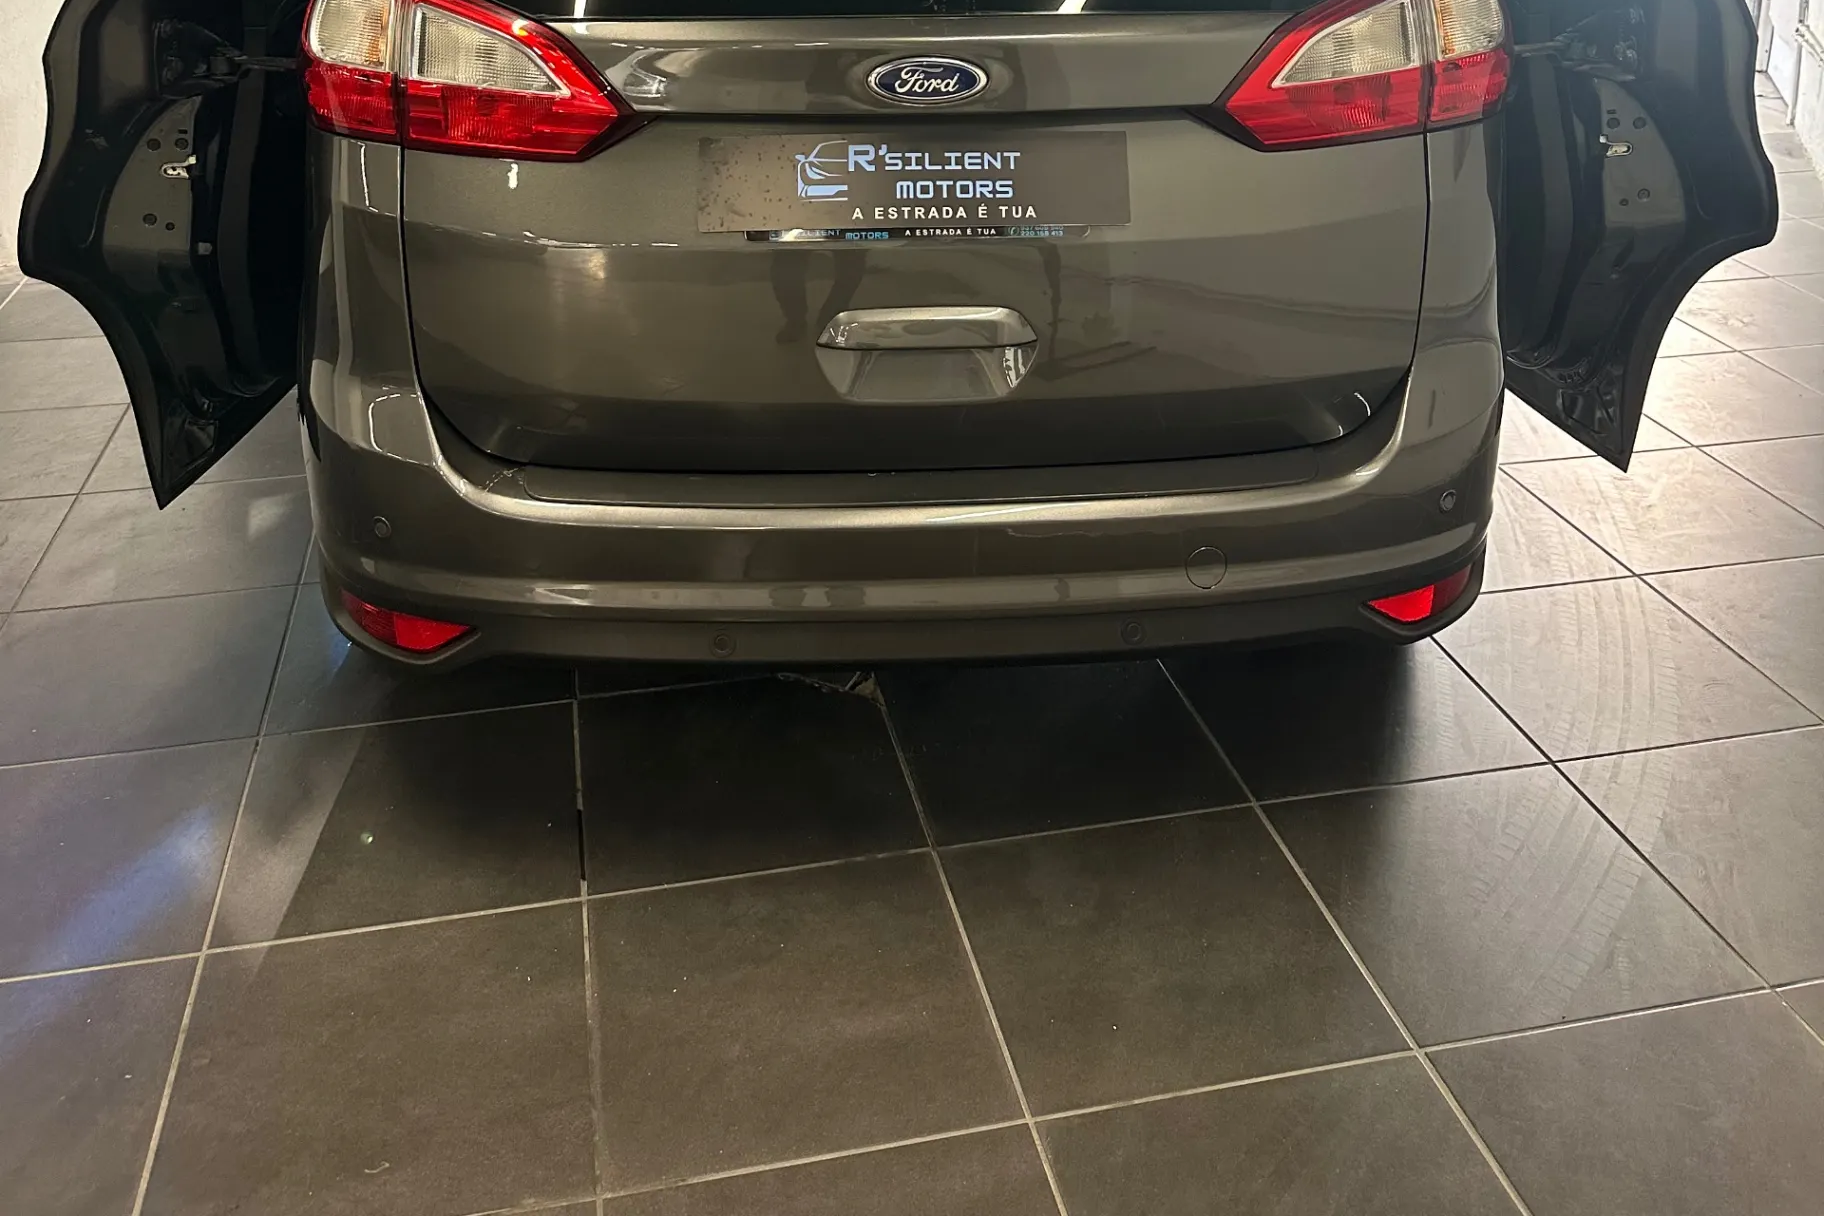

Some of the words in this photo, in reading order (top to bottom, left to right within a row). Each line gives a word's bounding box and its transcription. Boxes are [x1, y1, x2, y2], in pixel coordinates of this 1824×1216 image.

[894, 66, 960, 93] Ford
[847, 144, 1021, 172] R'SILIENT
[896, 180, 1013, 199] MOTORS
[851, 207, 864, 220] A
[874, 206, 967, 220] ESTRADA
[978, 203, 988, 219] É
[998, 205, 1037, 219] TUA
[845, 232, 889, 240] MOTORS
[916, 228, 962, 236] ESTRADA
[966, 226, 972, 235] É
